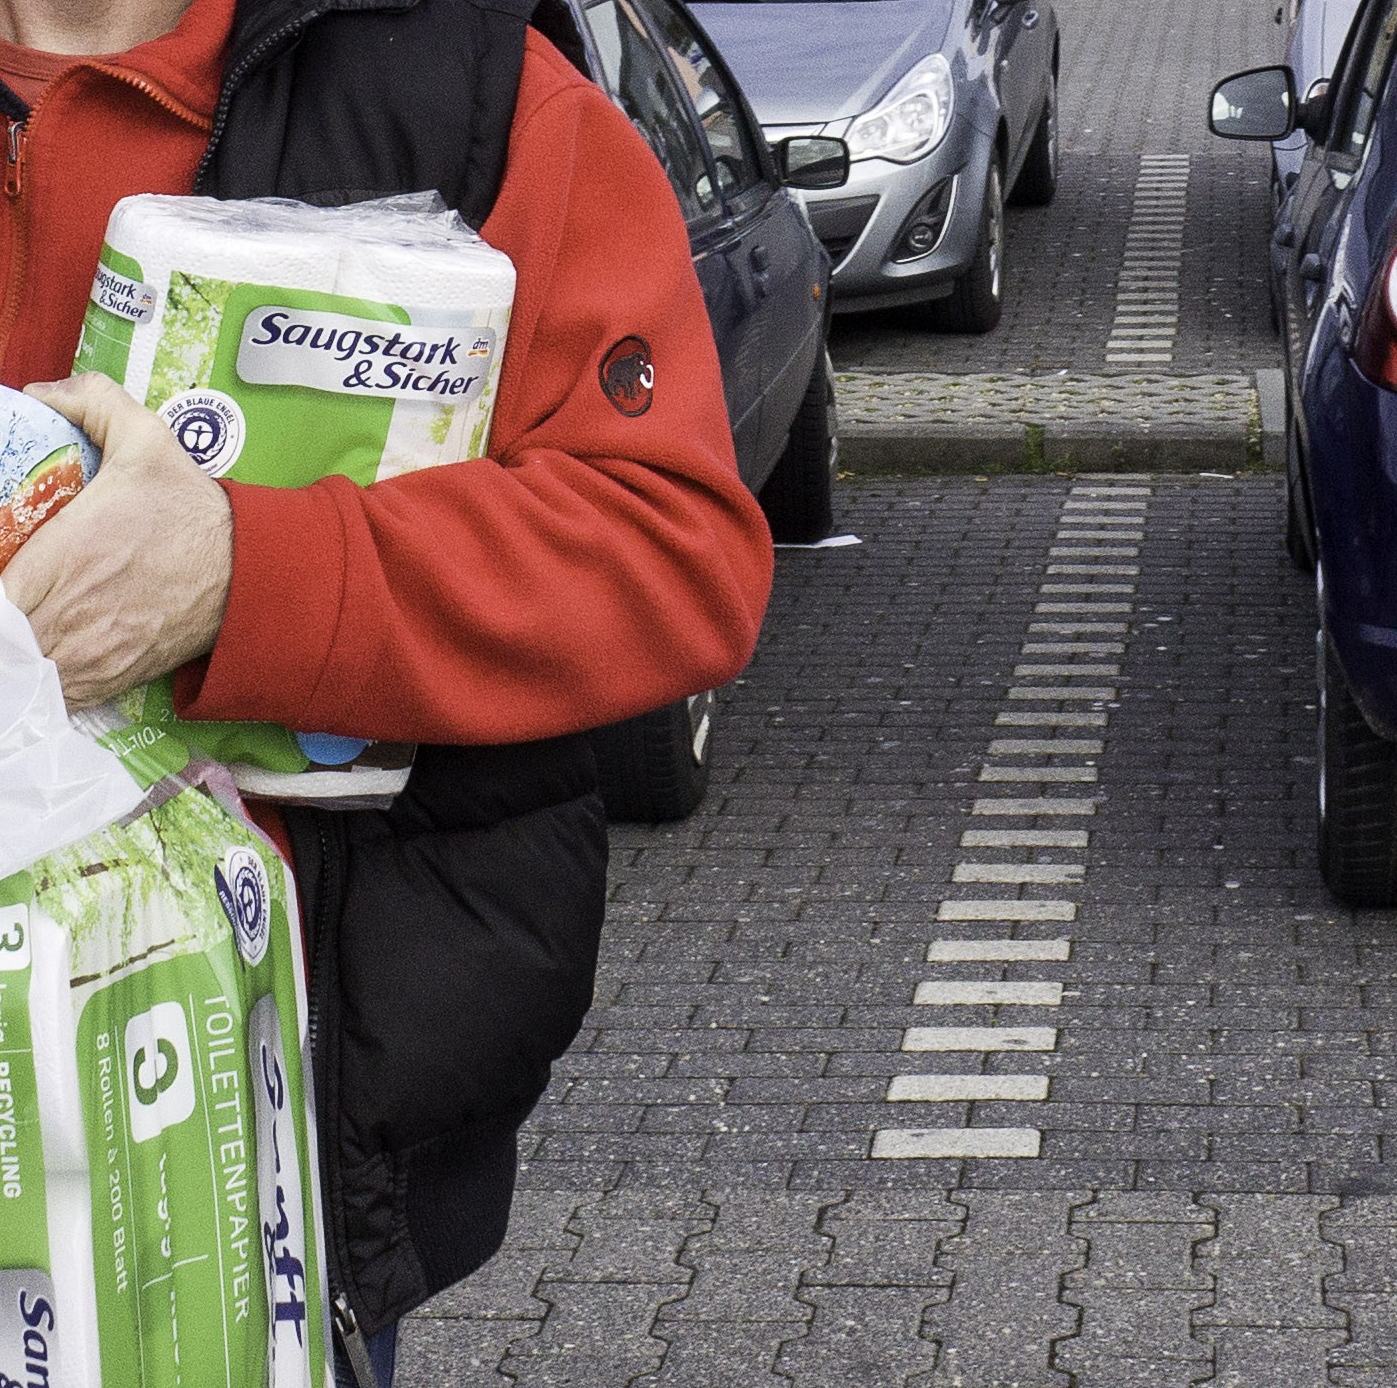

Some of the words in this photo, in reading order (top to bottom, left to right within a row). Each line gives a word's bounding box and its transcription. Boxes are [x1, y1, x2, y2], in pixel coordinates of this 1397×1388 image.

[95, 268, 137, 299] ugstark
[99, 289, 148, 318] &Sicher
[251, 312, 461, 364] Saugstark
[471, 337, 489, 351] dm
[342, 360, 479, 395] &Sicher
[167, 402, 184, 418] DER
[186, 397, 215, 407] BLAUE
[216, 401, 235, 425] ENGEL
[96, 1032, 110, 1048] 8
[132, 1037, 179, 1106] 3
[97, 1058, 117, 1143] Rollen
[106, 1148, 118, 1163] à
[203, 995, 251, 1323] TOILETTENPAPIER
[107, 1167, 123, 1220] 200
[260, 1043, 306, 1349] Snft
[111, 1229, 128, 1295] Blatt
